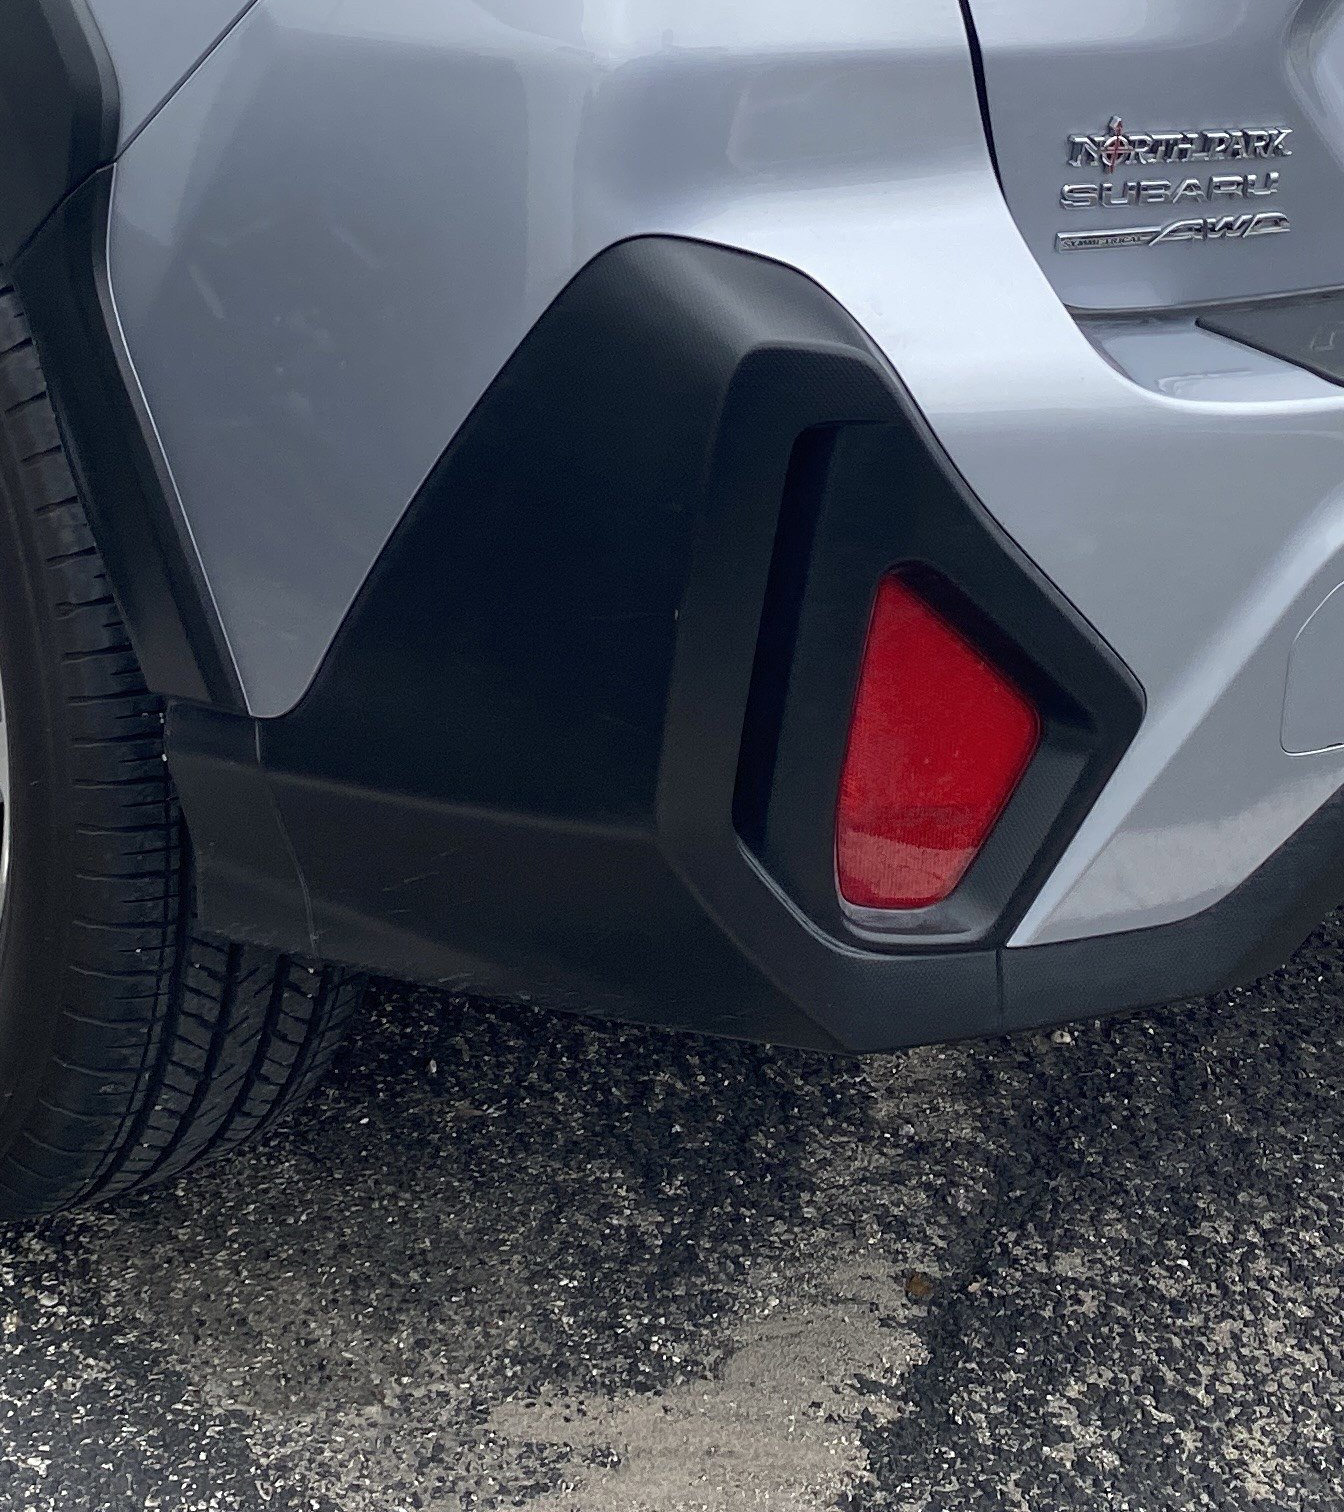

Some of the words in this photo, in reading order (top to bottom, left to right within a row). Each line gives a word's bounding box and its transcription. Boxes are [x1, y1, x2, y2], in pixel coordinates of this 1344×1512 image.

[1067, 116, 1199, 173] NORTH
[1202, 125, 1293, 162] PARK
[1060, 171, 1280, 210] SUBARU
[1148, 211, 1291, 247] AWD
